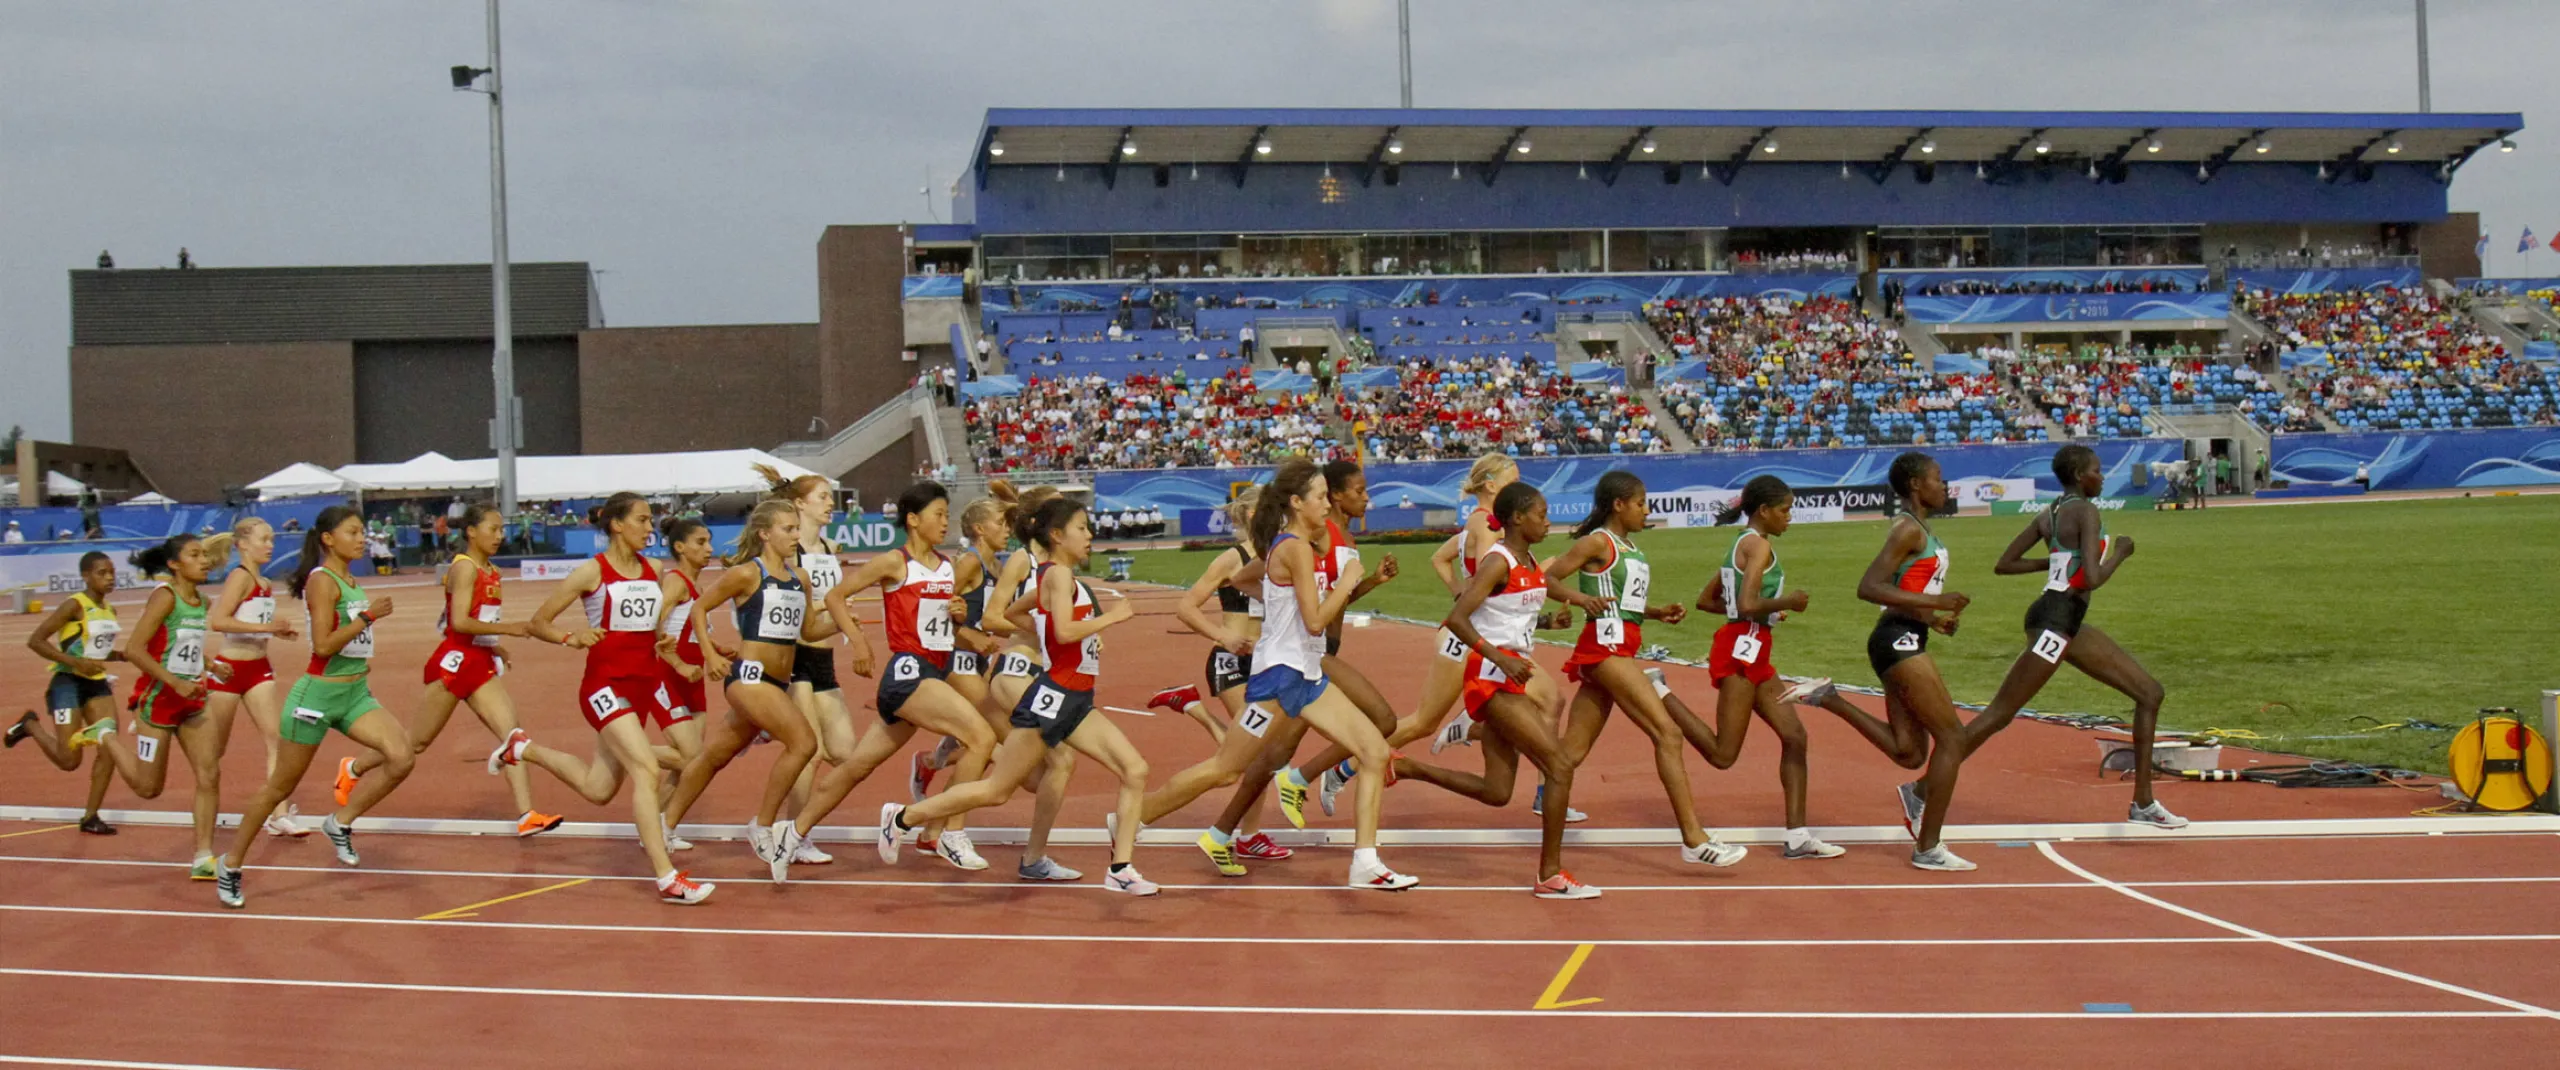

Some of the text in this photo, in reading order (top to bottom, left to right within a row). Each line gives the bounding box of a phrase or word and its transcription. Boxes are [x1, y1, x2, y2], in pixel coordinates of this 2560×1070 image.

[1648, 497, 1692, 513] KUM
[1826, 494, 1838, 508] &
[1687, 513, 1708, 526] Bell
[811, 570, 838, 588] 511
[620, 597, 657, 618] 637
[770, 606, 801, 627] 698
[1604, 622, 1617, 640] 4
[1446, 637, 1465, 657] 15
[1740, 640, 1752, 657] 2
[2040, 636, 2060, 658] 12
[448, 655, 462, 668] 5
[901, 658, 913, 675] 6
[957, 655, 974, 671] 10
[1008, 657, 1027, 673] 19
[1218, 657, 1236, 671] 16
[743, 665, 760, 681] 18
[594, 694, 613, 714] 13
[1039, 694, 1055, 711] 9
[1245, 709, 1268, 730] 17
[140, 740, 152, 757] 11
